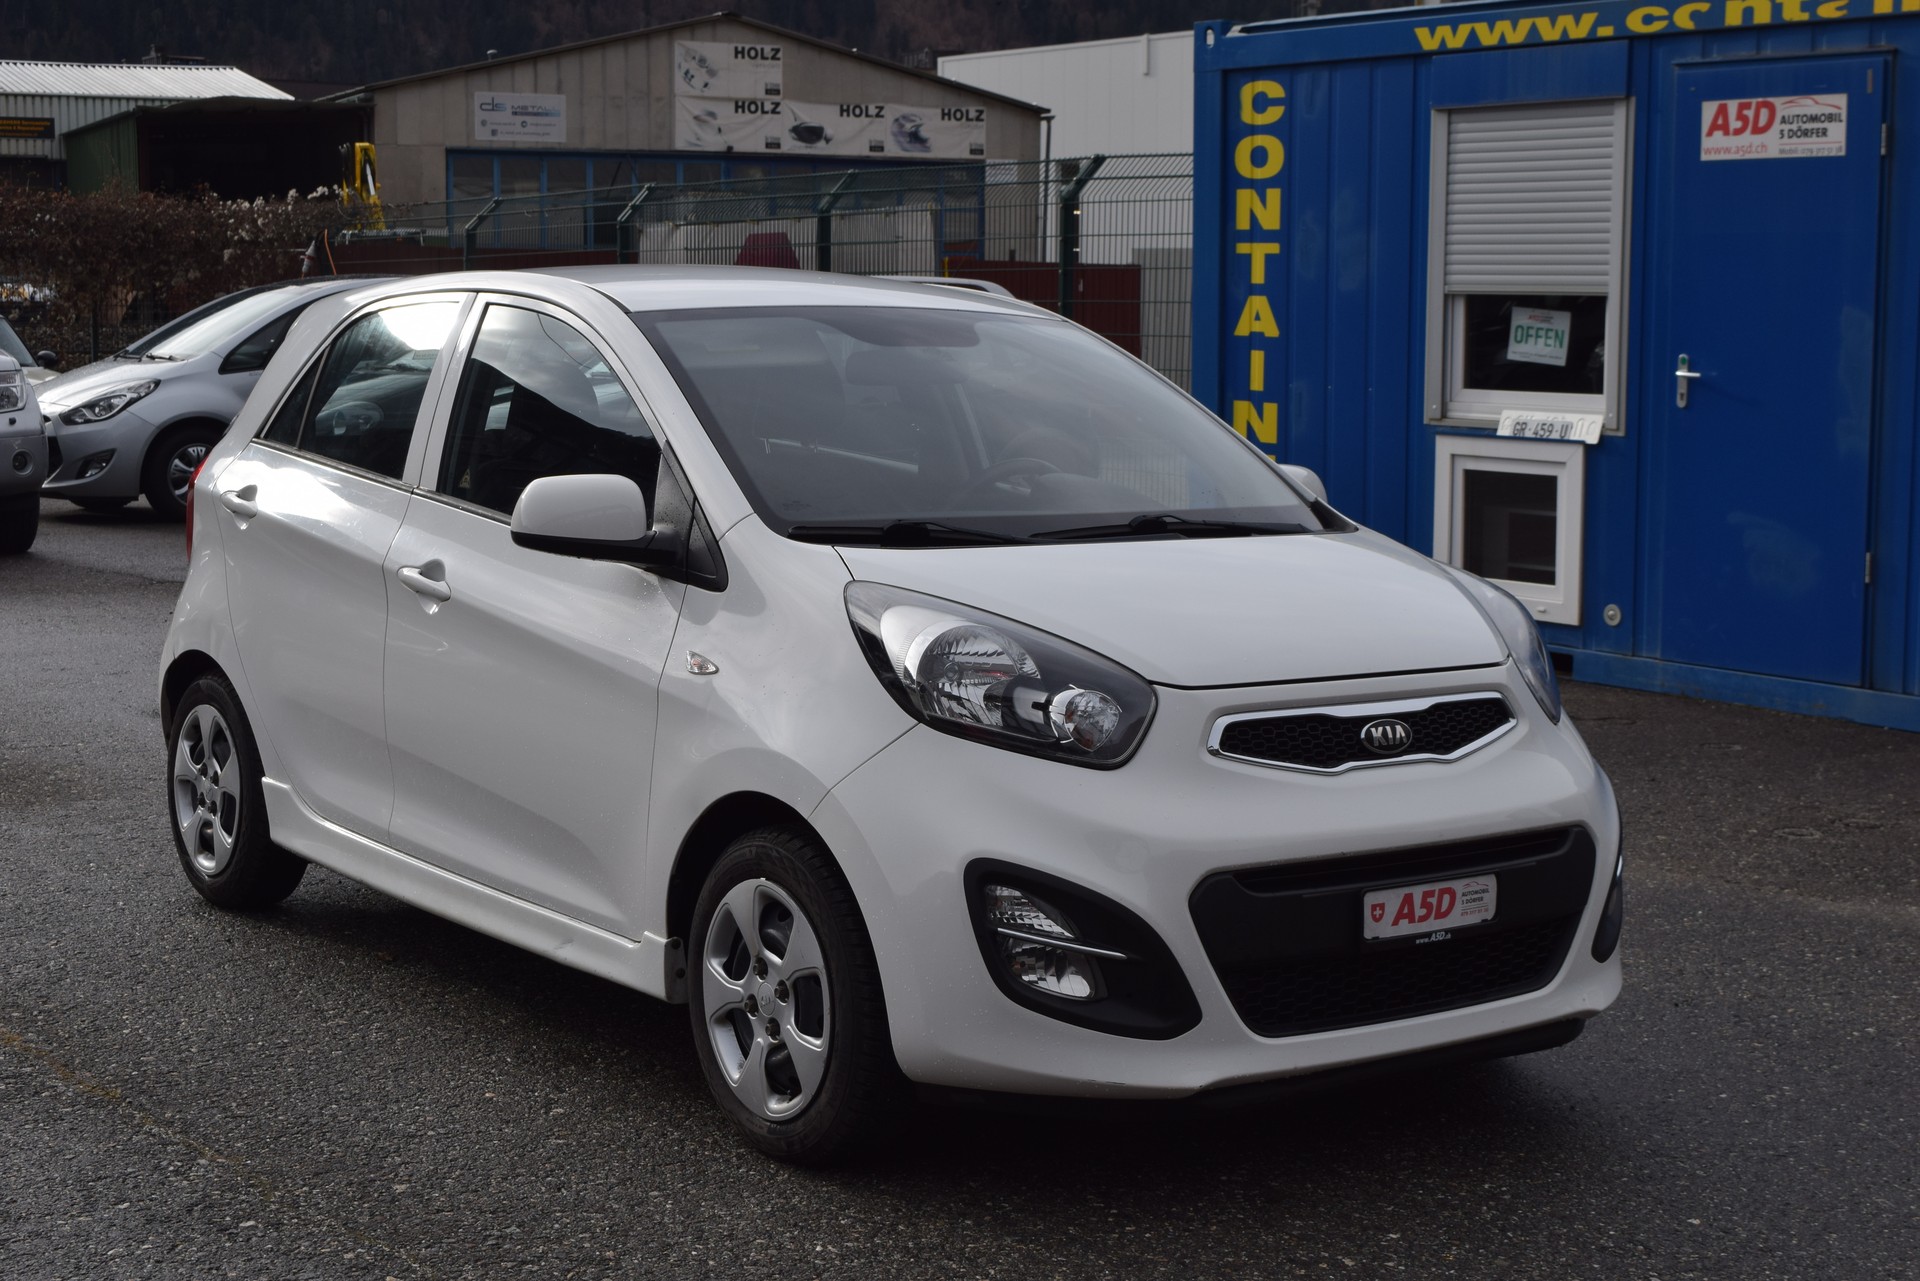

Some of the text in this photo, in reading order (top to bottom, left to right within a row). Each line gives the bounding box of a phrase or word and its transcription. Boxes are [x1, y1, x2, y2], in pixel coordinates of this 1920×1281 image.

[734, 46, 781, 61] HOLZ
[734, 100, 781, 115] HOLZ
[839, 103, 885, 119] HOLZ
[941, 107, 985, 123] HOLZ
[1705, 100, 1776, 137] A5D
[1780, 112, 1843, 125] AUTOMOBIL
[1779, 126, 1828, 140] 5 DÖRFER
[1703, 142, 1768, 157] www.a5d.ch
[1232, 79, 1286, 463] CONTAIN
[1514, 325, 1565, 349] OFFEN
[1370, 724, 1408, 747] KIA
[1461, 888, 1490, 897] AUTOMOBIL
[1391, 886, 1457, 927] A5D
